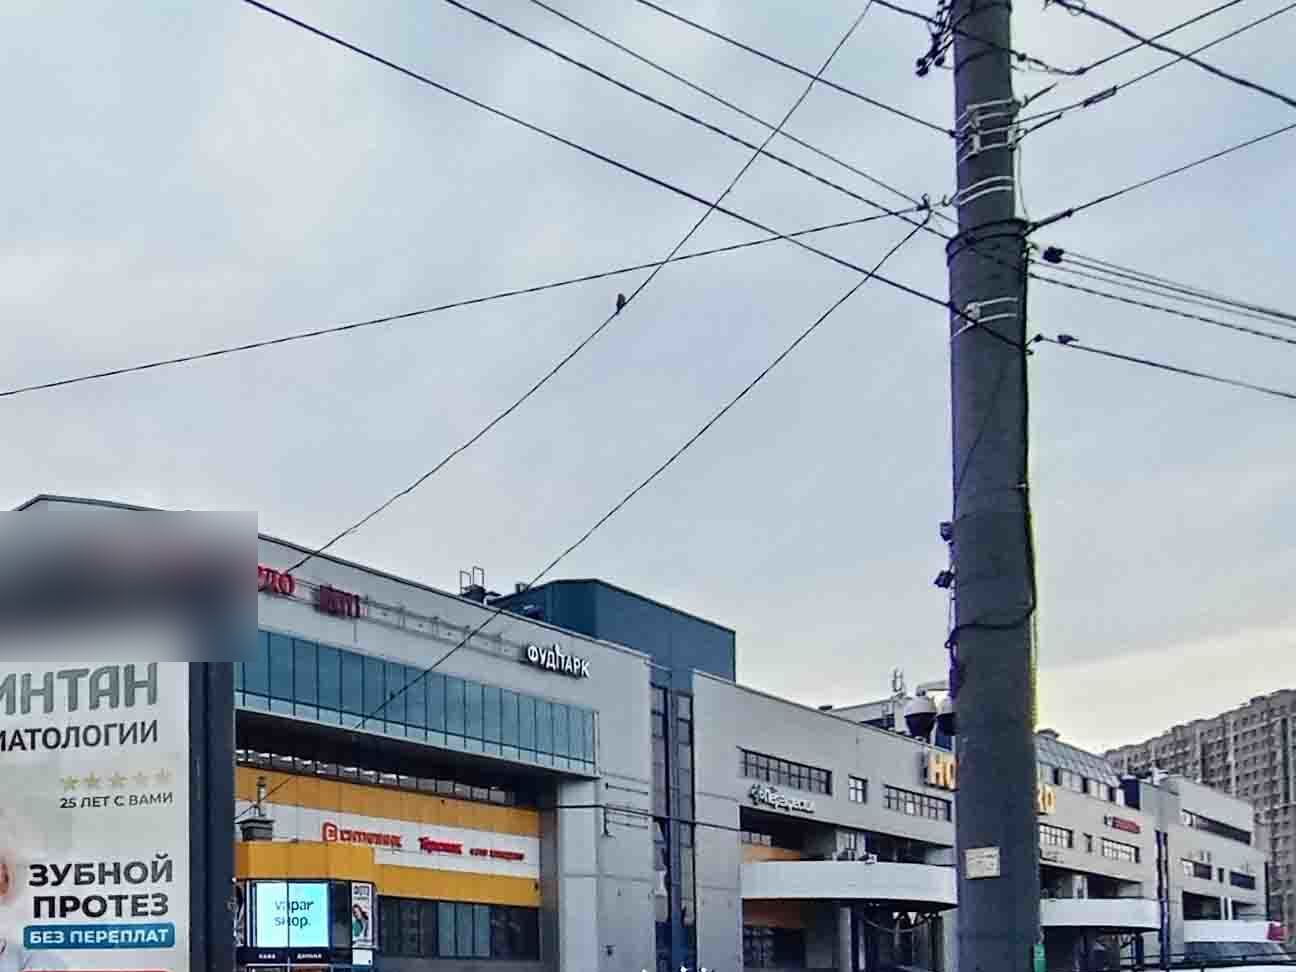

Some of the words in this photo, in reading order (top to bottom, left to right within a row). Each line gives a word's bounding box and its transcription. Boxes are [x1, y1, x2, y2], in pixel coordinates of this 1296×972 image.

[527, 643, 590, 677] ФУДПАРК
[59, 798, 77, 809] 25
[80, 796, 110, 808] ЛЕТ
[113, 795, 126, 807] С
[128, 792, 173, 807] ВАМИ
[28, 852, 174, 887] ЗУБНОЙ
[33, 892, 169, 919] ПРОТЕЗ
[29, 930, 65, 944] БЕЗ
[70, 928, 169, 944] ПЕРЕПЛАТ
